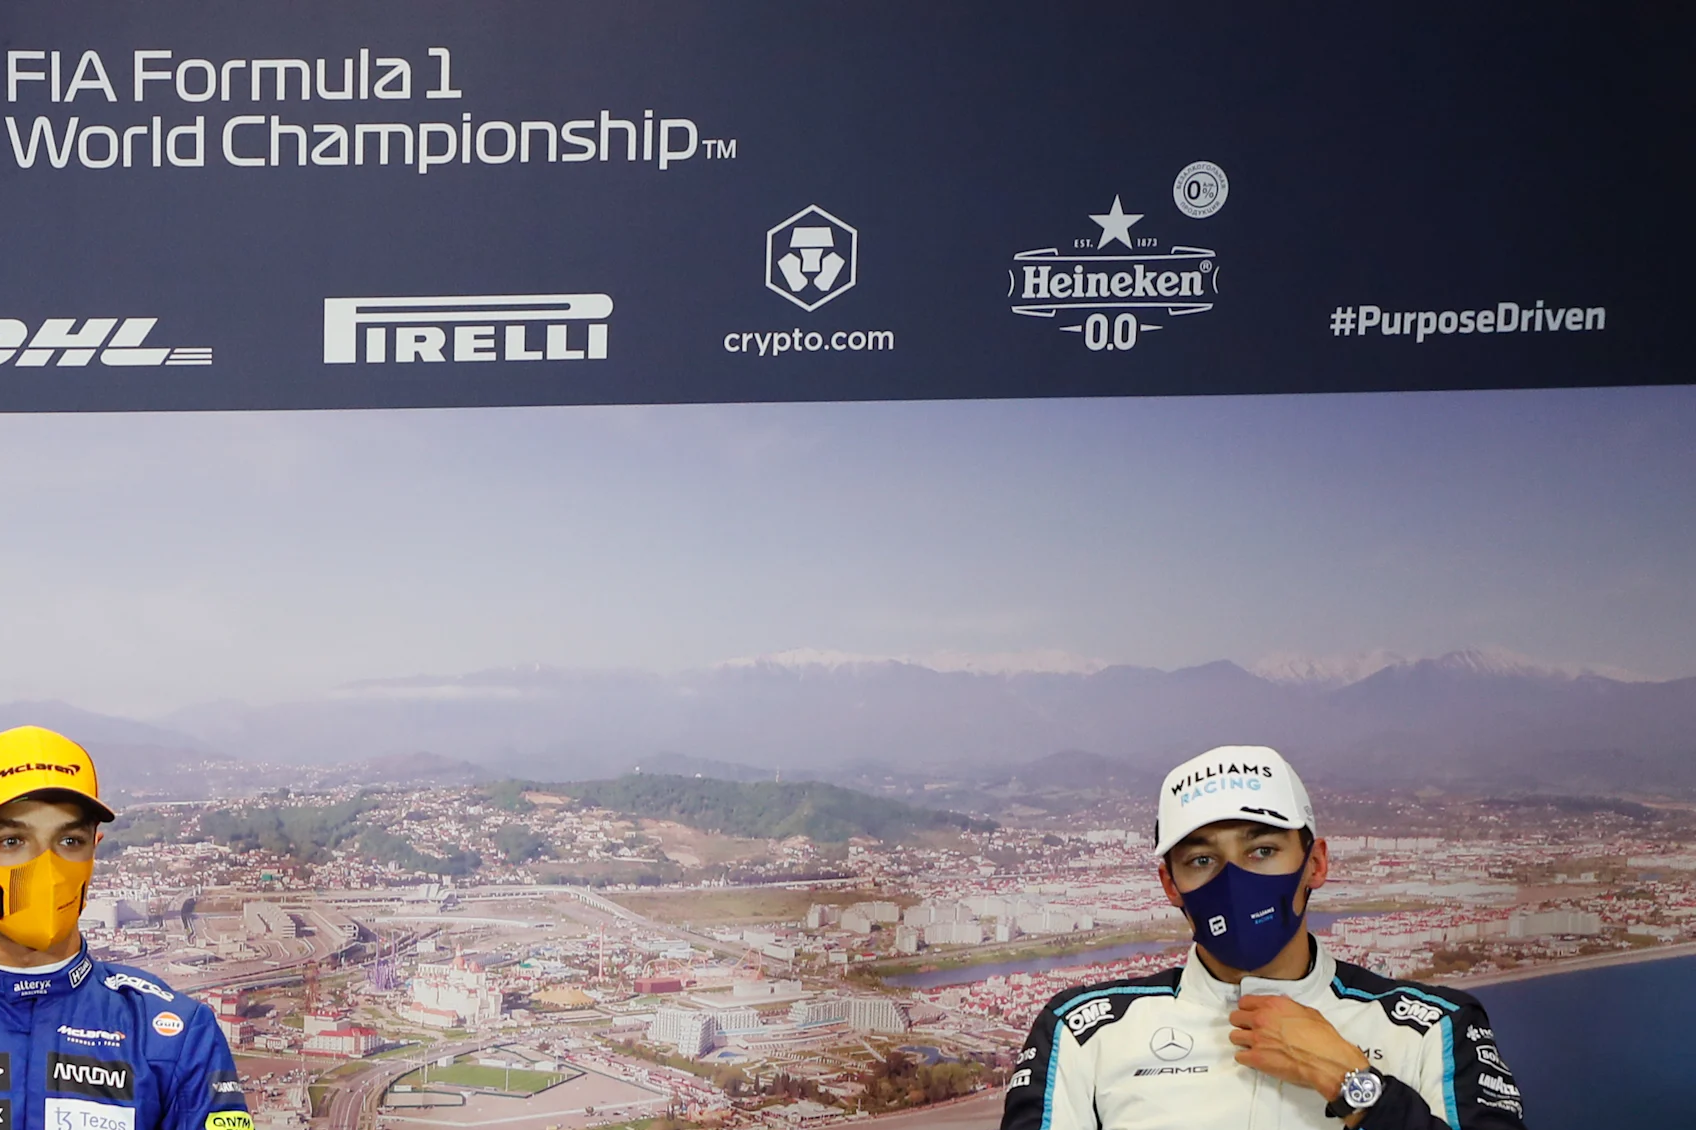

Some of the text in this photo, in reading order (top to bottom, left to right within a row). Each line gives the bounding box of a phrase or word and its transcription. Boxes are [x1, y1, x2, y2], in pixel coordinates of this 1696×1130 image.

[7, 47, 463, 102] FIA Formula 1
[5, 115, 205, 168] World
[222, 109, 700, 174] Championship
[1074, 238, 1094, 248] EST.
[1137, 238, 1157, 248] 1873
[324, 293, 614, 364] PIRELLI
[1085, 312, 1137, 351] 0.0
[1330, 300, 1605, 343] #PurposeDriven
[723, 327, 895, 357] crypto.com
[1171, 763, 1273, 796] WILLIAMS
[1180, 777, 1262, 807] RACING
[13, 979, 52, 993] alteryx
[1066, 998, 1114, 1035] OMP
[1391, 996, 1443, 1027] OMP
[57, 1025, 126, 1042] McLaren
[53, 1062, 127, 1089] ARROW
[1158, 1065, 1209, 1076] AMG
